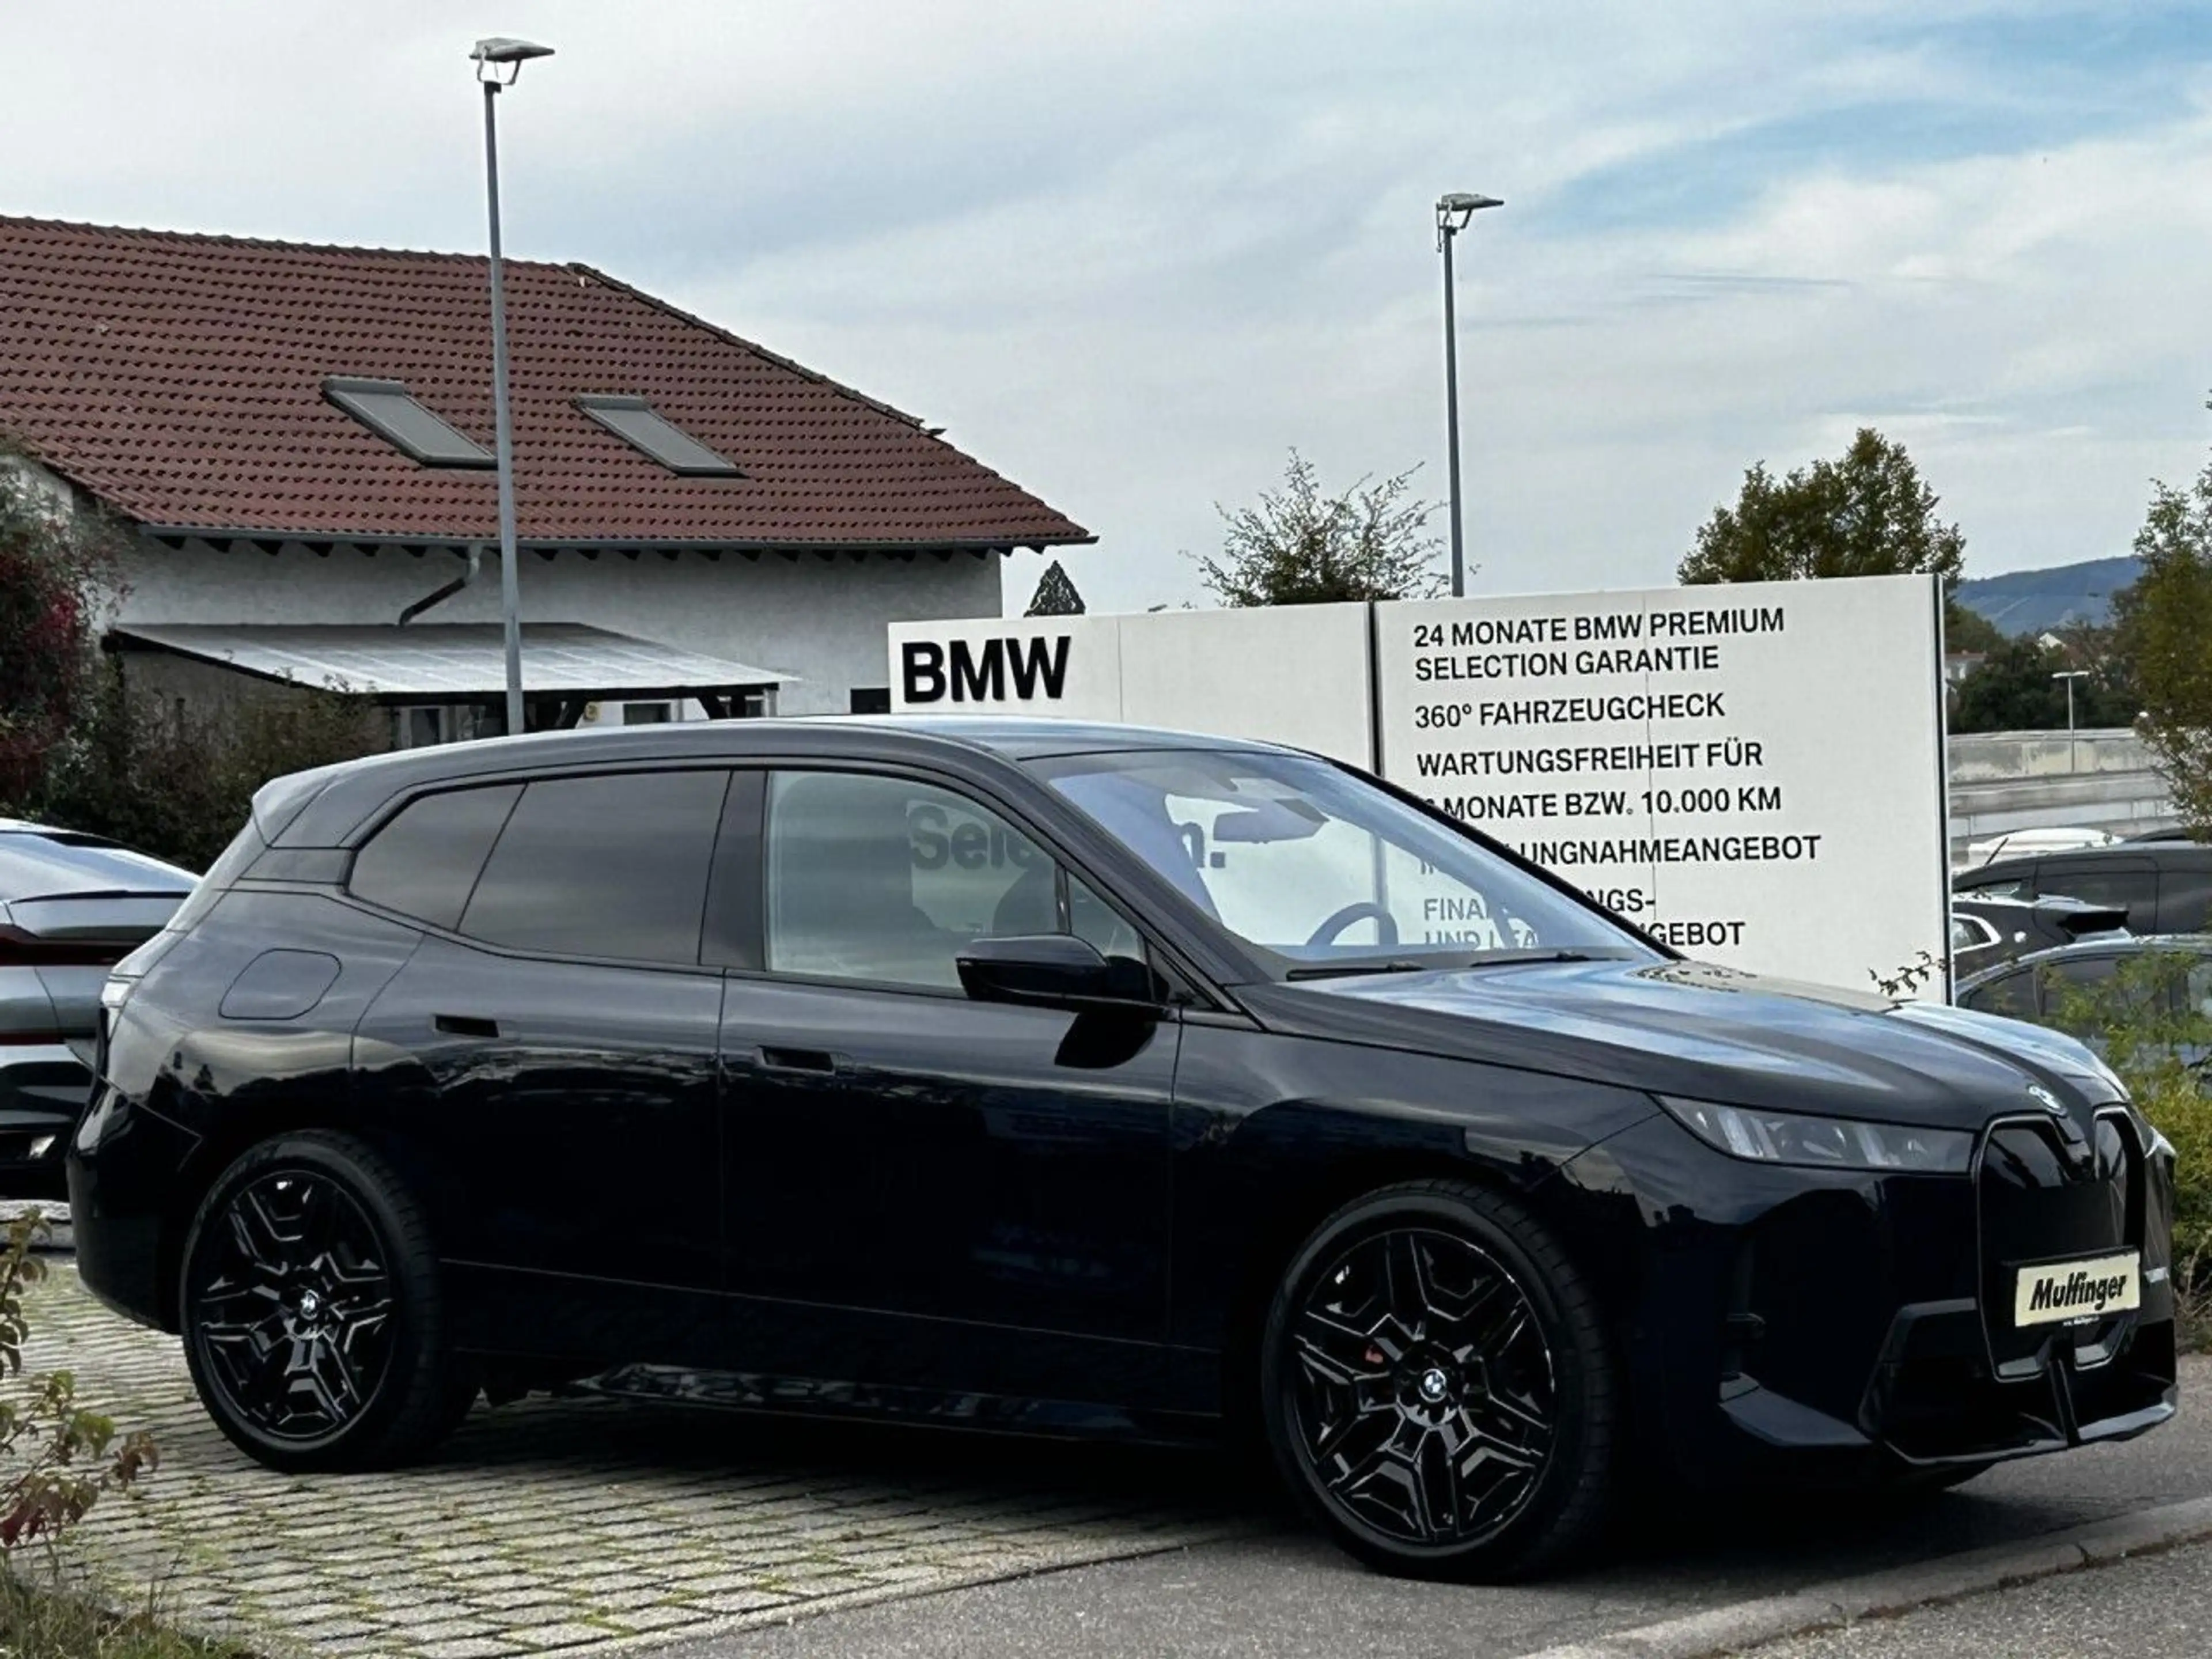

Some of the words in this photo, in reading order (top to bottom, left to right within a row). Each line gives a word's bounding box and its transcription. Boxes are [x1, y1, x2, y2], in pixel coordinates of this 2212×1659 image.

[1413, 624, 1444, 647] 24
[1452, 618, 1567, 646] MONATE
[1574, 614, 1642, 640] BMW
[1650, 607, 1785, 637] PREMIUM
[902, 635, 1071, 704] BMW
[1415, 652, 1567, 681] SELECTION
[1575, 645, 1719, 675] GARANTIE
[1479, 692, 1726, 726] FAHRZEUGCHECK
[1416, 744, 1700, 777] WARTUNGSFREIHEIT
[1707, 737, 1763, 767] FÜR
[1444, 794, 1558, 820] MONATE
[1565, 791, 1634, 816] BZW.
[1641, 788, 1730, 814] 10.000
[1738, 786, 1781, 812] KM
[2029, 1271, 2128, 1311] Mulfinger
